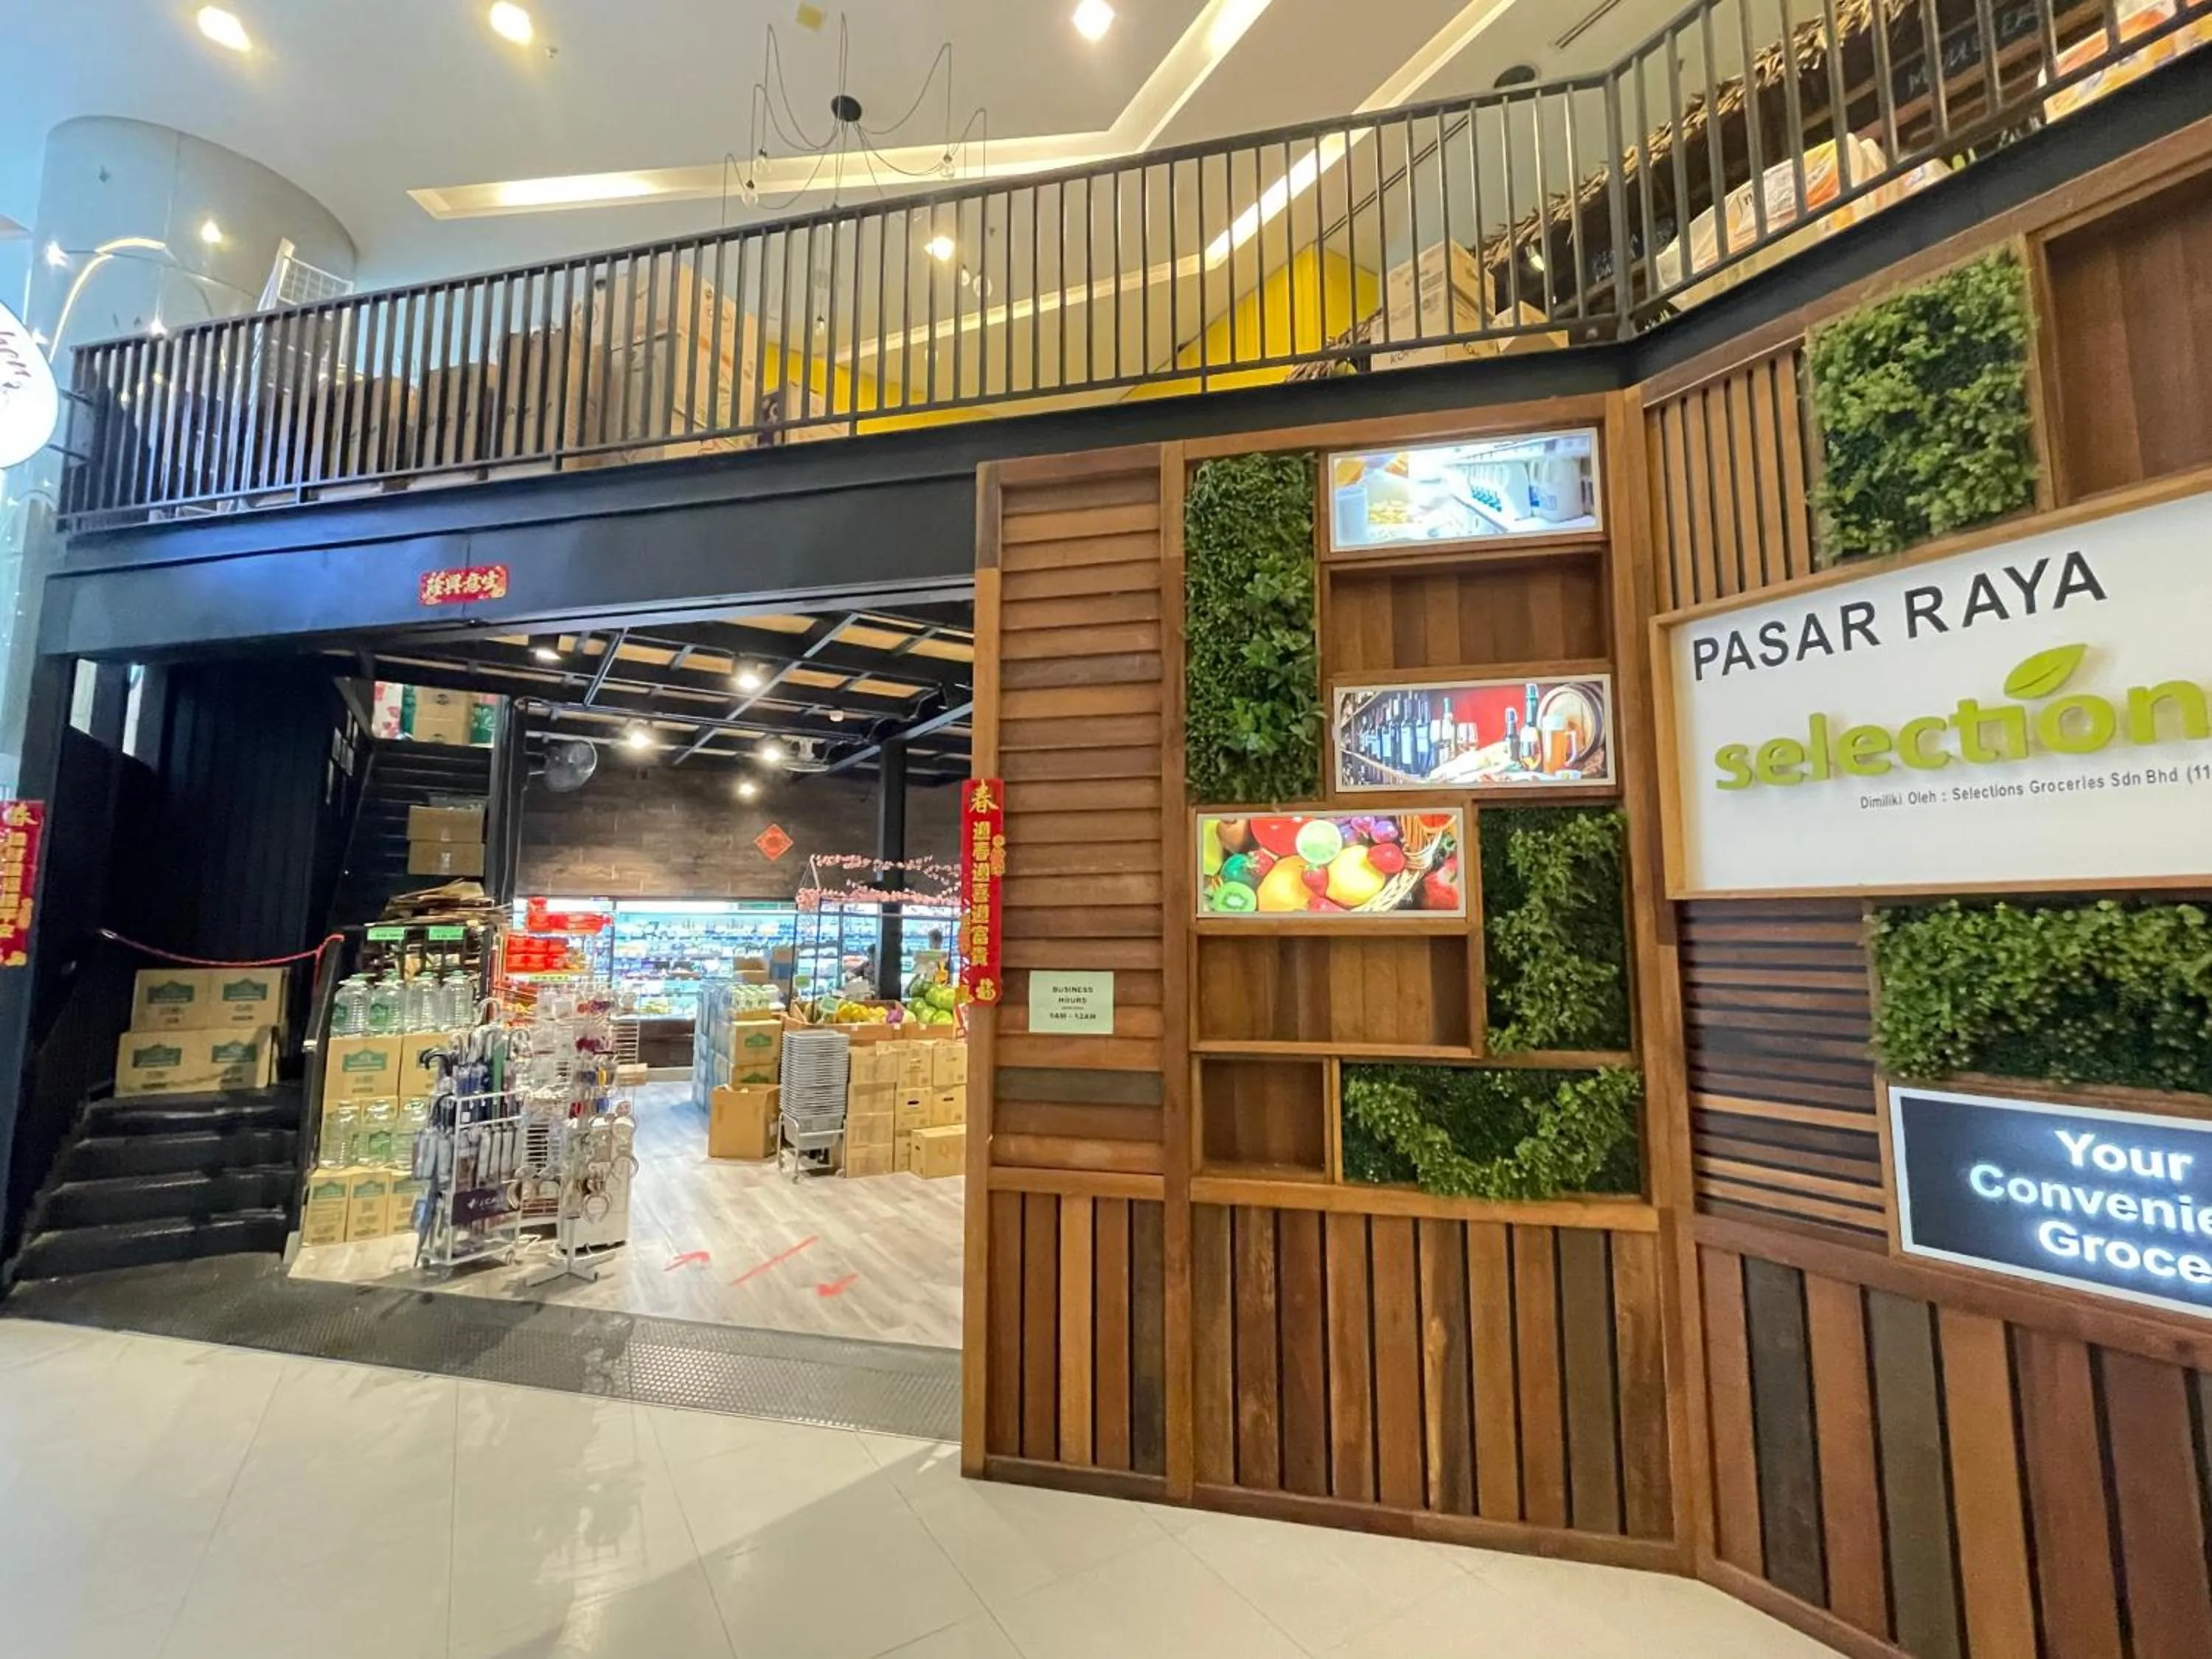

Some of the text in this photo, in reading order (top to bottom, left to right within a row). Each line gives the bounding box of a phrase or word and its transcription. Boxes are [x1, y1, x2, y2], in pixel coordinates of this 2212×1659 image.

[1693, 550, 2108, 681] PASAR RAYA
[1714, 678, 2212, 790] selection
[968, 779, 1000, 814] 春
[1860, 792, 1903, 809] Dimiliki
[1907, 789, 1937, 804] Oleh
[1952, 782, 2025, 801] Selections
[2029, 772, 2105, 794] Groceries
[2110, 770, 2141, 787] Sdn
[2146, 766, 2179, 784] Bhd
[2054, 1130, 2194, 1181] Your
[2038, 1220, 2212, 1284] Groce
